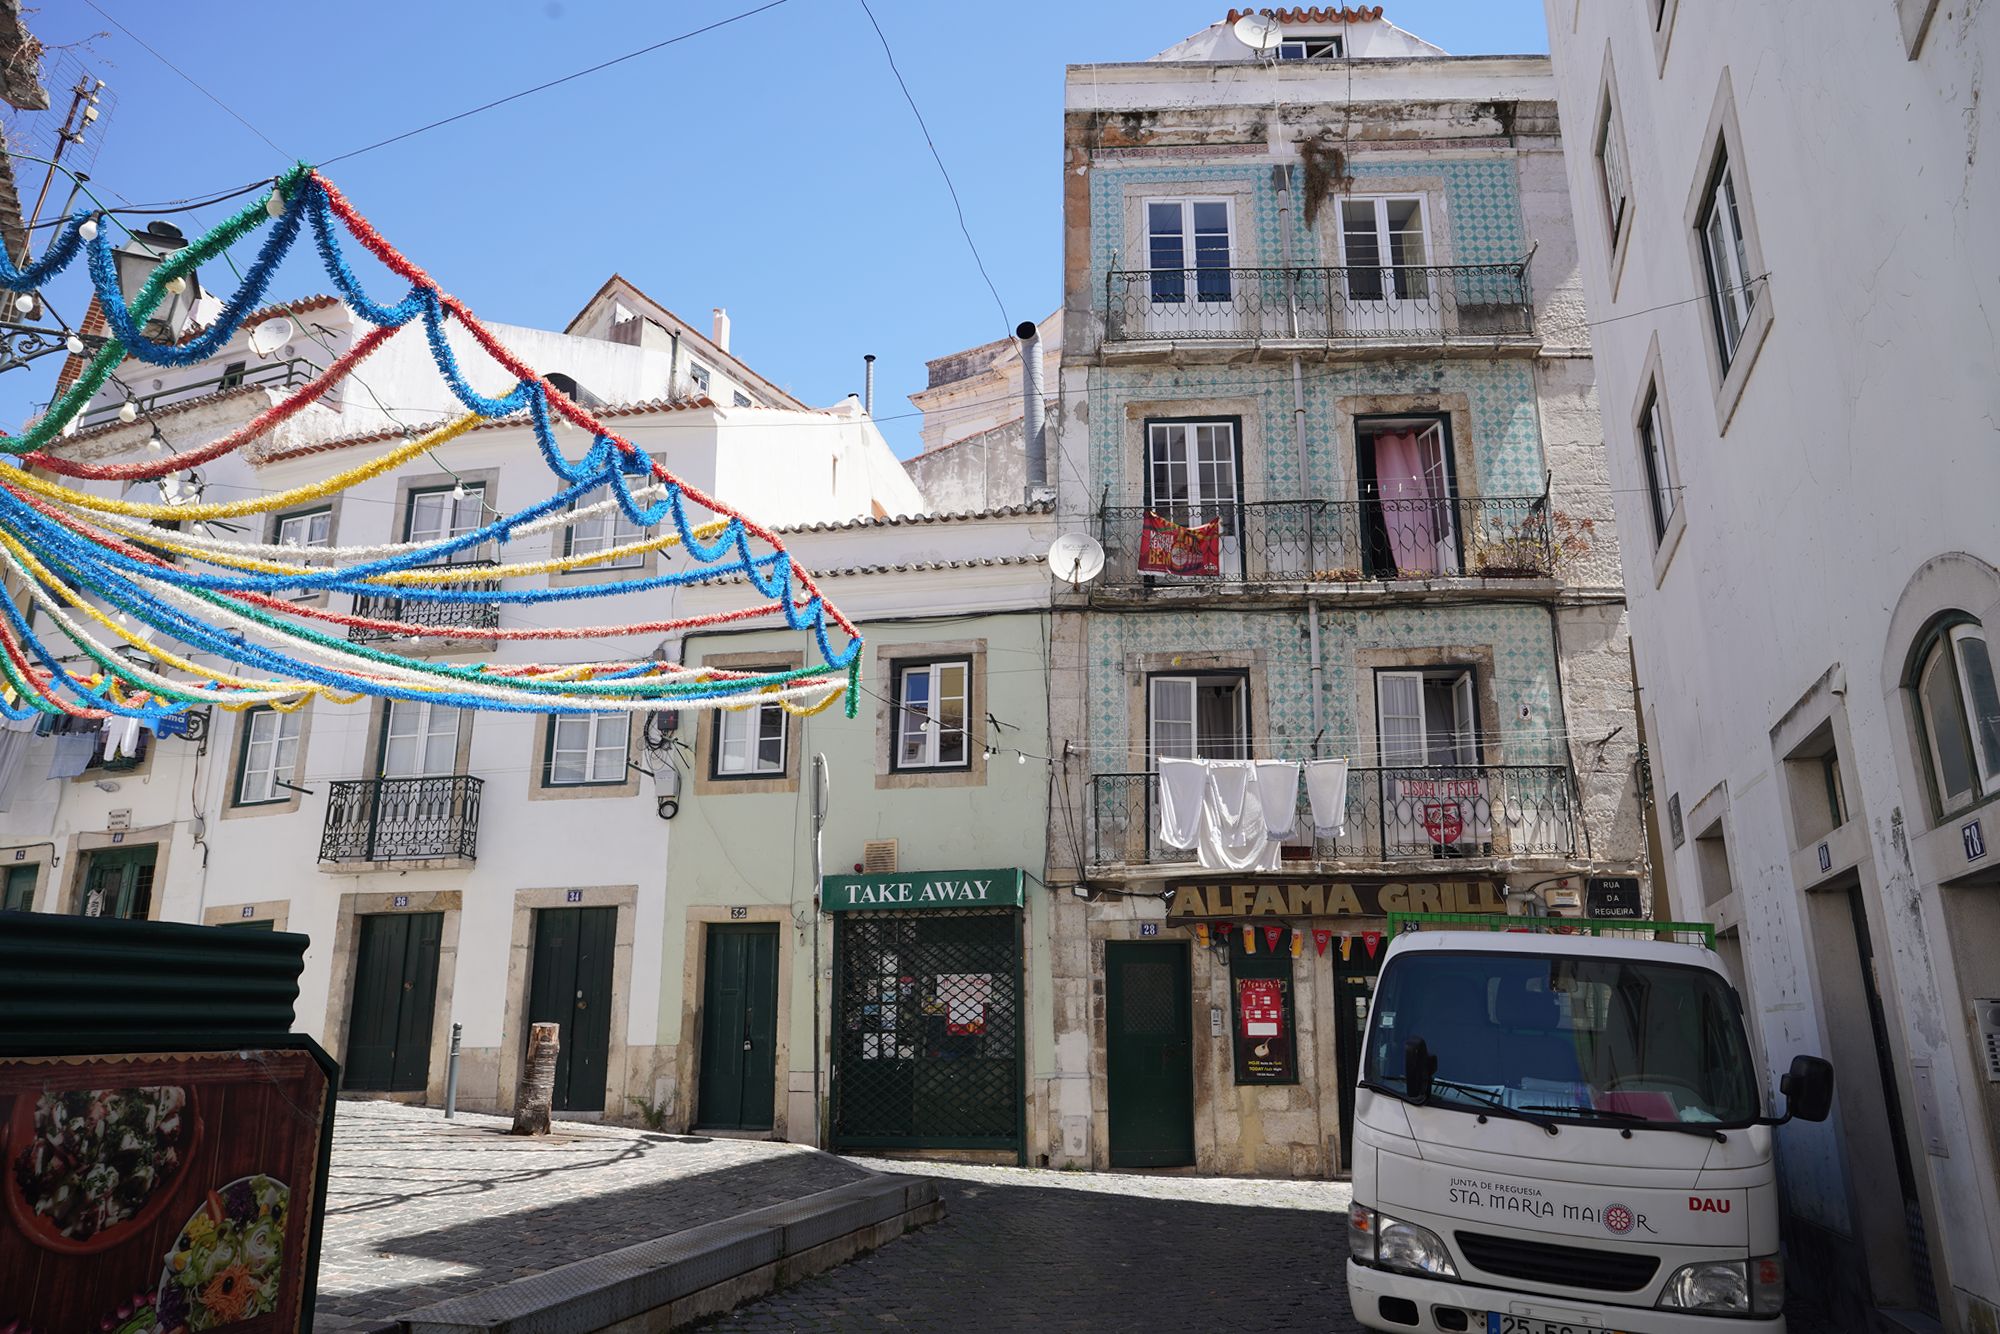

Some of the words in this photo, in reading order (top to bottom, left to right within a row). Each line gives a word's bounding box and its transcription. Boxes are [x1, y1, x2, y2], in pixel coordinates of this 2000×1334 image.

[1963, 824, 1982, 857] 78
[1602, 881, 1621, 889] RUA
[844, 882, 914, 905] TAKE
[918, 880, 993, 902] AWAY
[1168, 883, 1364, 916] ALFAMA
[1377, 881, 1506, 913] GRILL
[1606, 894, 1620, 902] DA
[395, 896, 407, 907] 36
[732, 907, 747, 918] 32
[1594, 907, 1635, 916] REGUEIRA
[1143, 924, 1156, 936] 28
[1404, 920, 1419, 931] 26
[1450, 1177, 1478, 1189] JUNTA
[1480, 1182, 1493, 1191] DE
[1494, 1183, 1543, 1197] FREGUESIA
[1449, 1188, 1485, 1207] STA.
[1489, 1194, 1554, 1218] MARIA
[1688, 1196, 1731, 1214] DAU
